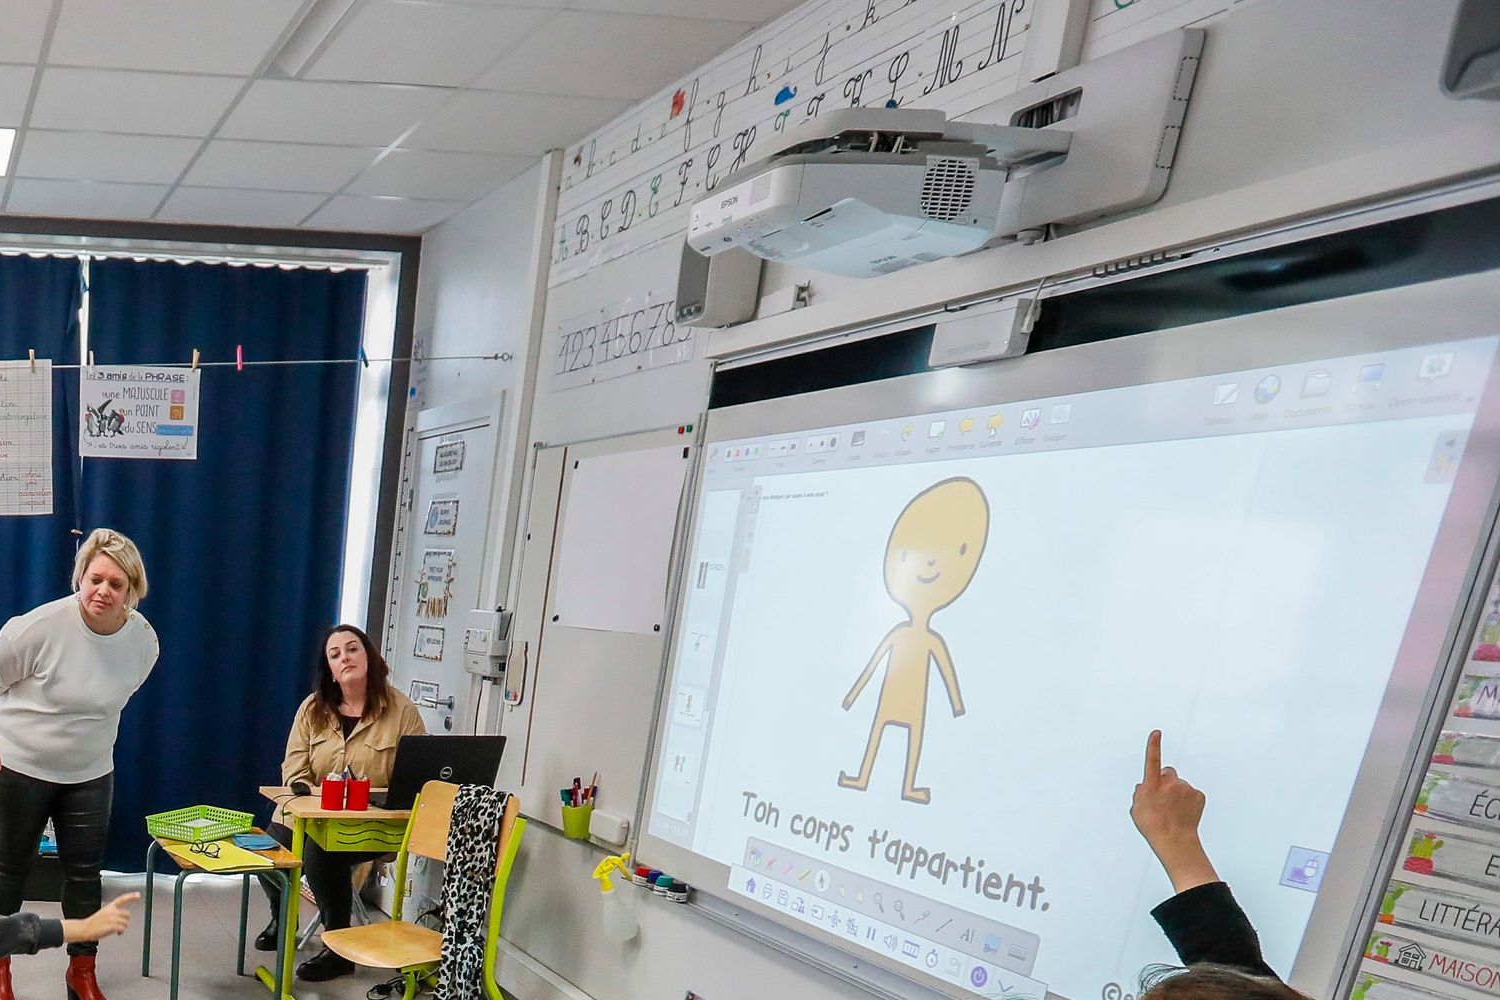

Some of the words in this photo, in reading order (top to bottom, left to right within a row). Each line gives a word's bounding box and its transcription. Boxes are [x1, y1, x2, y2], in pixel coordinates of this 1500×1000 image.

[721, 195, 739, 209] EPSON
[106, 371, 128, 380] amis
[122, 387, 169, 401] MAJUSCULE
[135, 404, 160, 417] POINT
[124, 424, 134, 434] du
[137, 421, 157, 434] SENS
[1469, 789, 1500, 821] ÉC
[790, 813, 854, 853] corps
[868, 829, 1051, 913] t'appartient.
